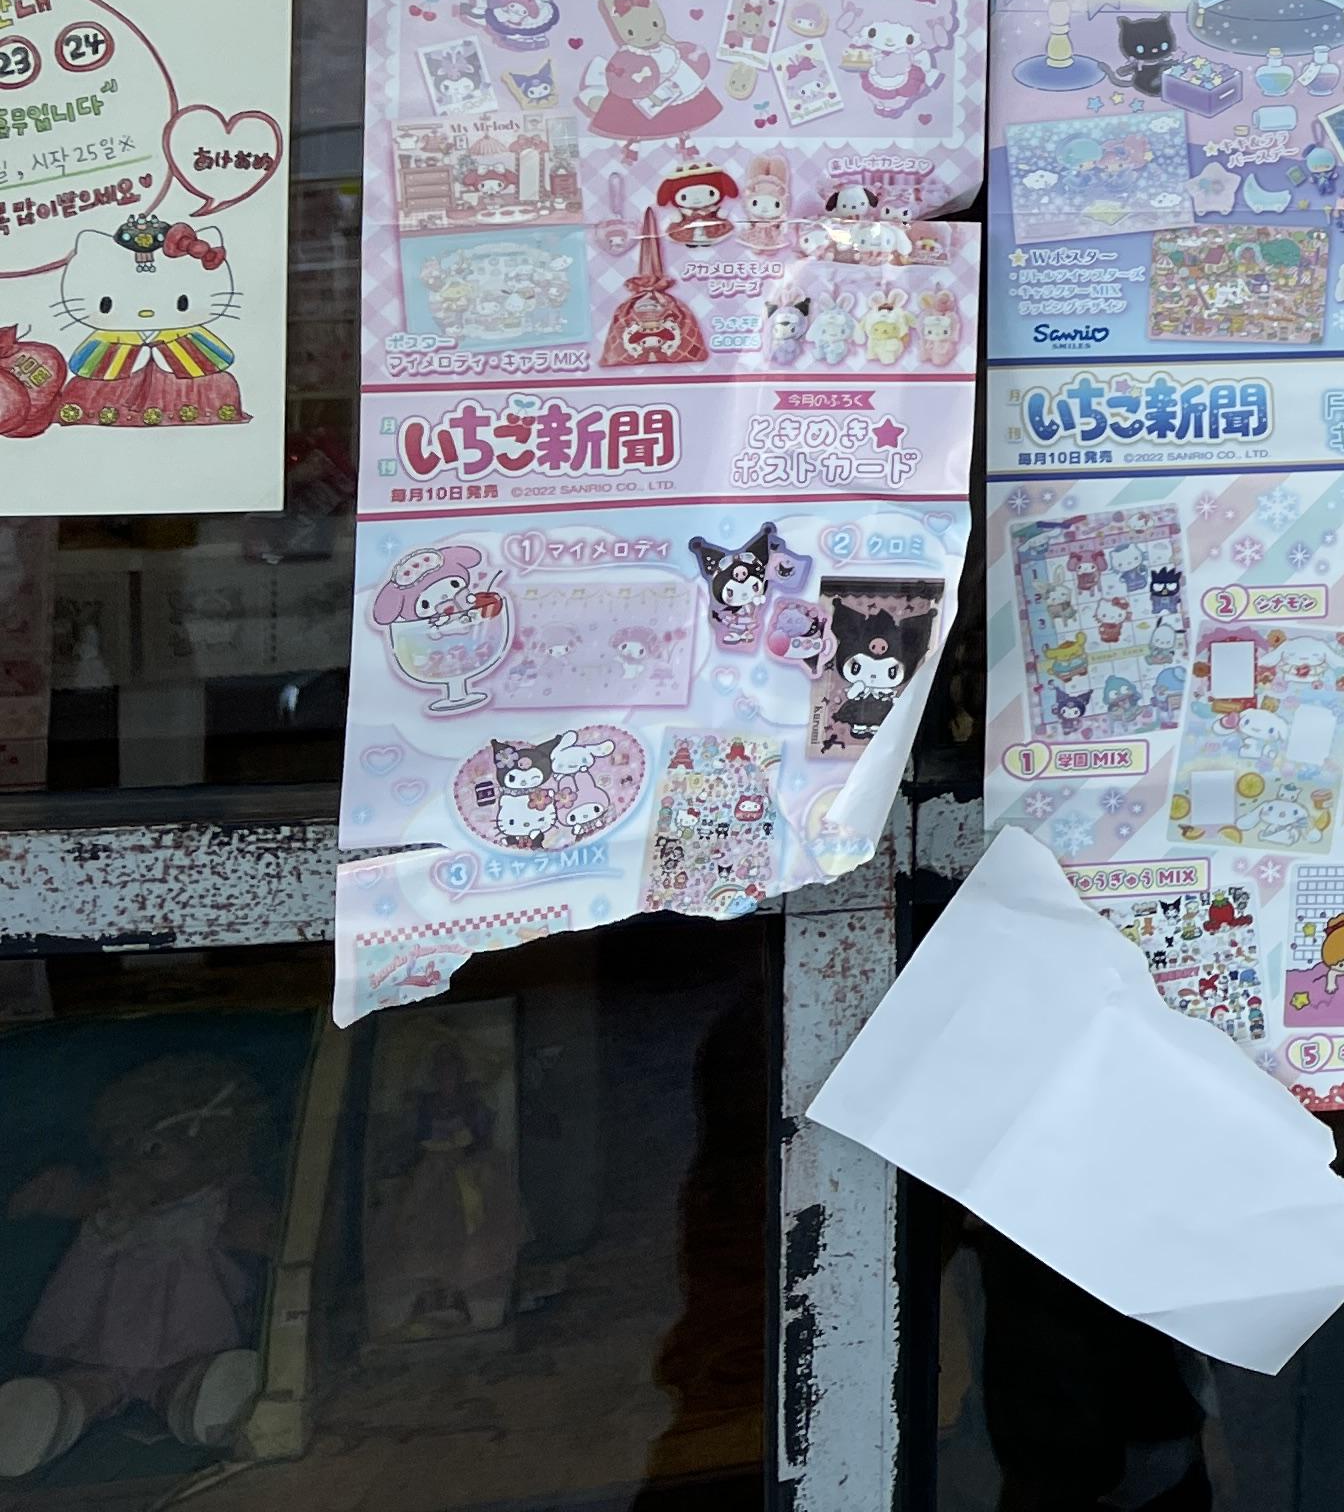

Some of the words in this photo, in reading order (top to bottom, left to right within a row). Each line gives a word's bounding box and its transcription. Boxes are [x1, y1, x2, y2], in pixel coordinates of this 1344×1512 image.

[64, 33, 105, 61] 24
[193, 146, 275, 172] あけおめ
[709, 280, 762, 296] シリーズ
[387, 335, 455, 352] ポスター
[1033, 323, 1110, 343] Sanrio
[788, 393, 865, 407] 今月のふろく
[1026, 376, 1270, 443] いちご新聞
[403, 402, 676, 477] いちご新聞
[733, 451, 919, 485] ポストカード
[1018, 450, 1113, 466] 毎月10日発売
[1166, 450, 1215, 462] SANRIO
[390, 484, 499, 503] 毎月10日発売
[559, 482, 613, 496] SANRIO
[547, 539, 671, 561] マイメロディ
[832, 532, 852, 555] 2
[868, 536, 926, 555] クロミ
[1217, 594, 1236, 614] 2
[1253, 591, 1319, 615] シナモン
[1019, 750, 1033, 773] 1
[1055, 748, 1132, 770] 学園MIX
[449, 862, 469, 886] 3
[1156, 866, 1198, 886] MIX
[1301, 1043, 1319, 1067] 5
